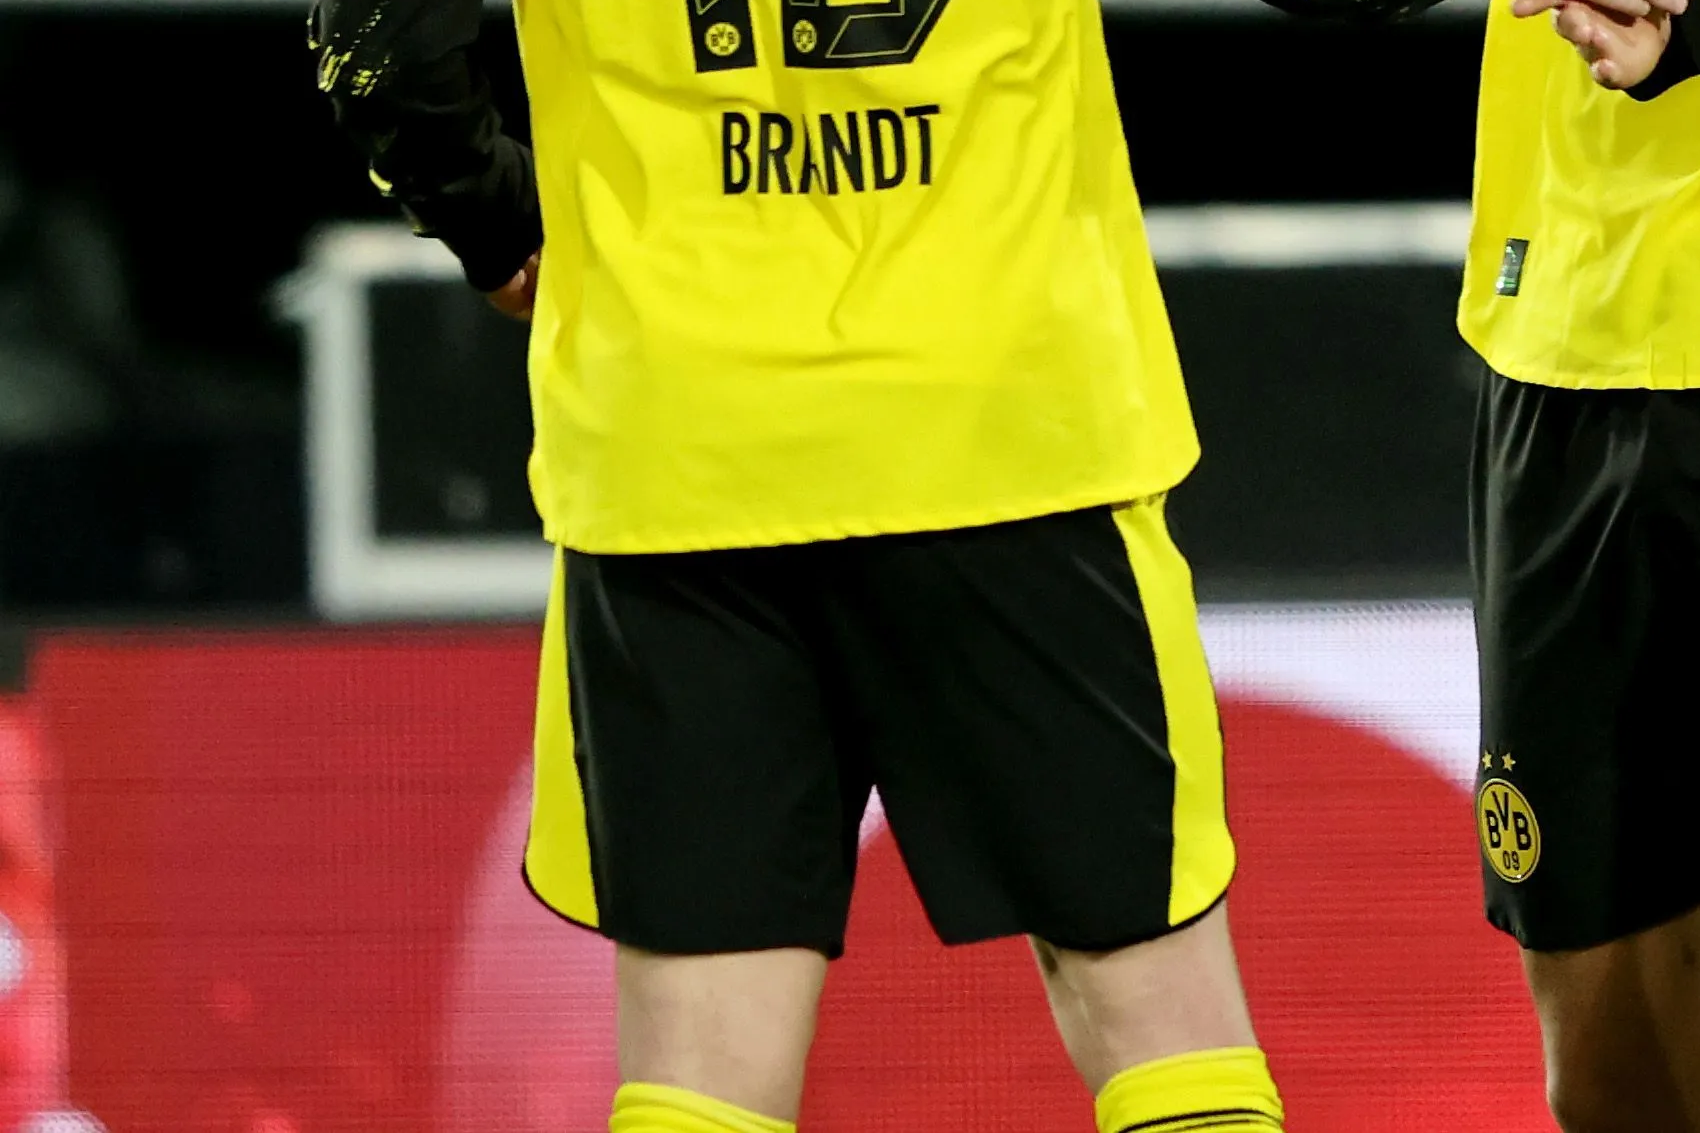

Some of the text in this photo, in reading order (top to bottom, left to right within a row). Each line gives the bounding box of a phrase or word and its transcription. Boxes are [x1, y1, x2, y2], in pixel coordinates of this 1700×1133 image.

[721, 104, 941, 196] BRANDT
[1484, 790, 1531, 851] BVB
[1502, 850, 1520, 870] 09
